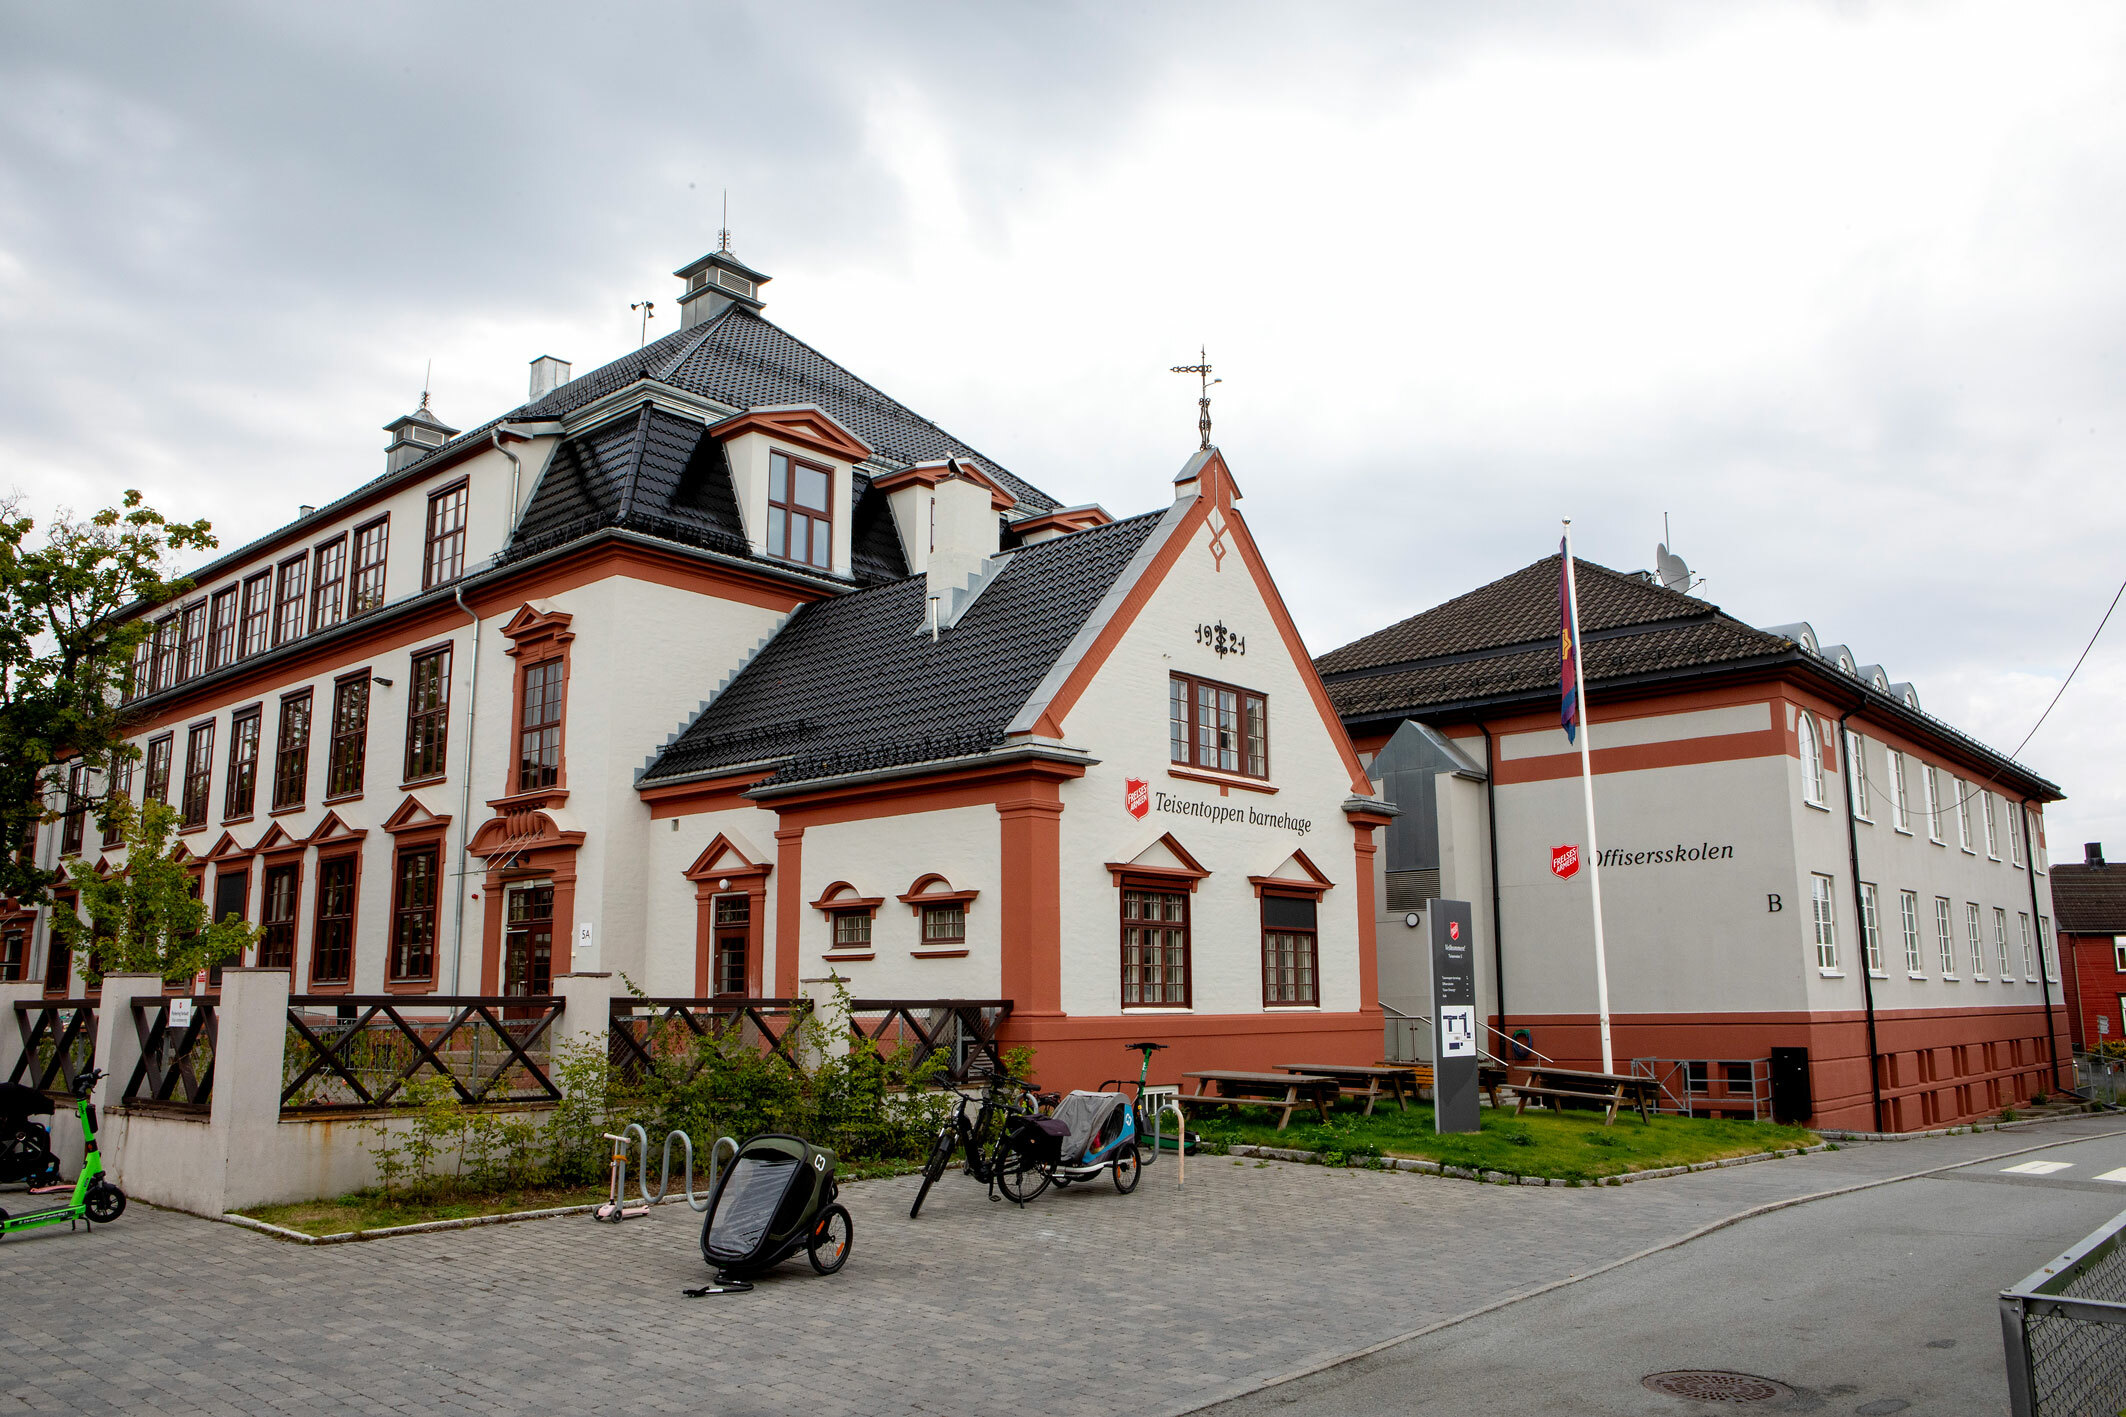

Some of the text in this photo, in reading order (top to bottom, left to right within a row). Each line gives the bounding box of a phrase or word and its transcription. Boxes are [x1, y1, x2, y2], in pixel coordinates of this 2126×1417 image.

[1127, 783, 1147, 805] FRELSES
[1155, 791, 1311, 836] Teisentoppen barnehage
[1552, 847, 1577, 868] FRELSES
[1556, 854, 1577, 873] ARMEEN
[1766, 893, 1783, 913] B
[582, 929, 591, 940] 5A
